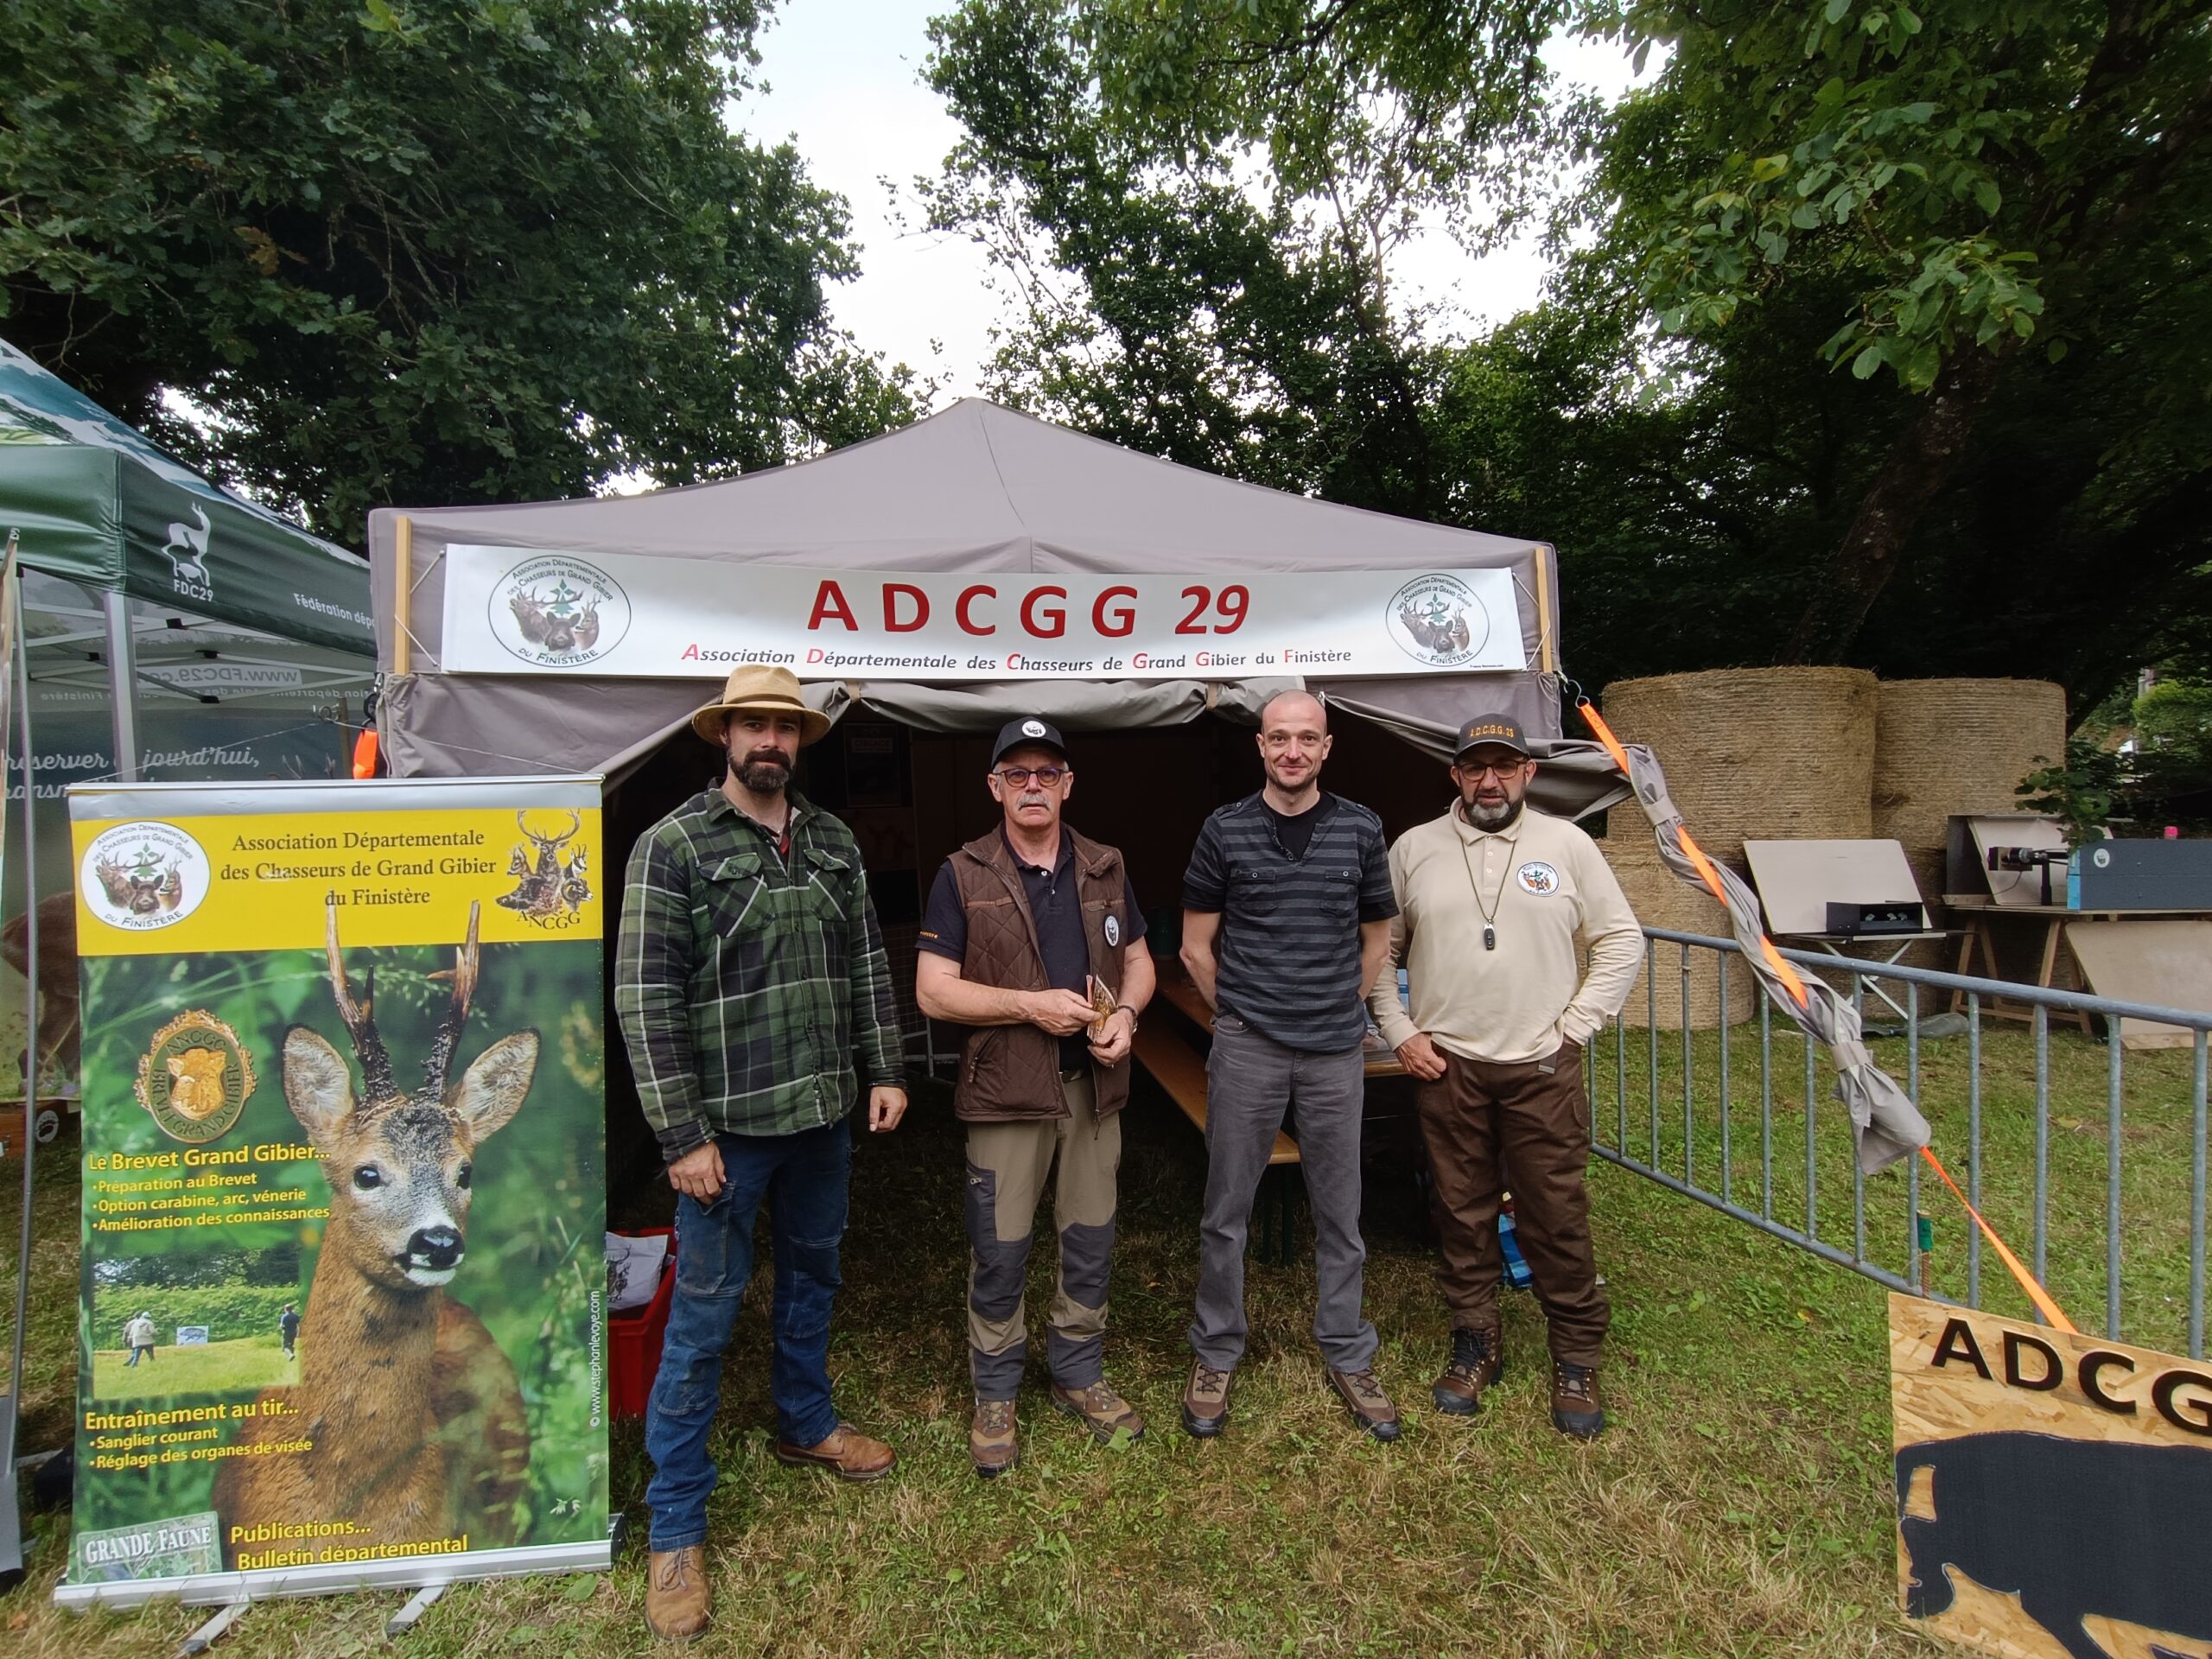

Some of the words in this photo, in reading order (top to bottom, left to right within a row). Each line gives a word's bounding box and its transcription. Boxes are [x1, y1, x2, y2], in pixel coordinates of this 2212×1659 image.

[174, 579, 214, 602] FDC29
[294, 593, 353, 622] Fédération
[1174, 584, 1250, 636] 29
[681, 643, 796, 664] Association
[805, 647, 957, 671] Départementale
[966, 654, 997, 671] des
[1006, 653, 1094, 672] Chasseurs
[1102, 656, 1123, 671] de
[1132, 652, 1186, 670] Grand
[1195, 650, 1246, 668] Gibier
[1255, 652, 1276, 666] du
[1284, 647, 1352, 664] Finistère
[232, 831, 339, 852] Association
[341, 828, 485, 850] Départementale
[220, 862, 250, 881] des
[256, 860, 346, 880] Chasseurs
[351, 859, 372, 878] de
[377, 857, 434, 877] Grand
[439, 856, 497, 876] Gibier
[324, 889, 347, 908] du
[352, 887, 431, 907] Finistère
[517, 910, 581, 930] ANCGG
[89, 1154, 106, 1171] Le
[111, 1150, 179, 1170] Brevet
[183, 1145, 250, 1166] Grand
[254, 1142, 331, 1163] Gibier...
[99, 1176, 183, 1194] Préparation
[186, 1177, 206, 1189] au
[209, 1173, 257, 1187] Brevet
[99, 1198, 147, 1214] Option
[149, 1194, 219, 1212] carabine,
[223, 1193, 250, 1206] arc,
[252, 1188, 307, 1204] vénerie
[99, 1214, 193, 1231] Amélioration
[196, 1211, 223, 1227] des
[226, 1206, 330, 1225] connaissances
[85, 1402, 226, 1431] Entraînement
[231, 1403, 257, 1420] au
[260, 1398, 300, 1418] tir...
[96, 1429, 156, 1452] Sanglier
[159, 1427, 219, 1445] courant
[96, 1449, 157, 1472] Réglage
[161, 1447, 188, 1465] des
[191, 1443, 251, 1464] organes
[254, 1440, 273, 1456] de
[276, 1438, 313, 1454] visée
[86, 1530, 157, 1565] GRANDE
[157, 1523, 212, 1550] FAUNE
[231, 1518, 372, 1545] Publications...
[238, 1548, 316, 1571] Bulletin
[319, 1534, 468, 1565] départemental
